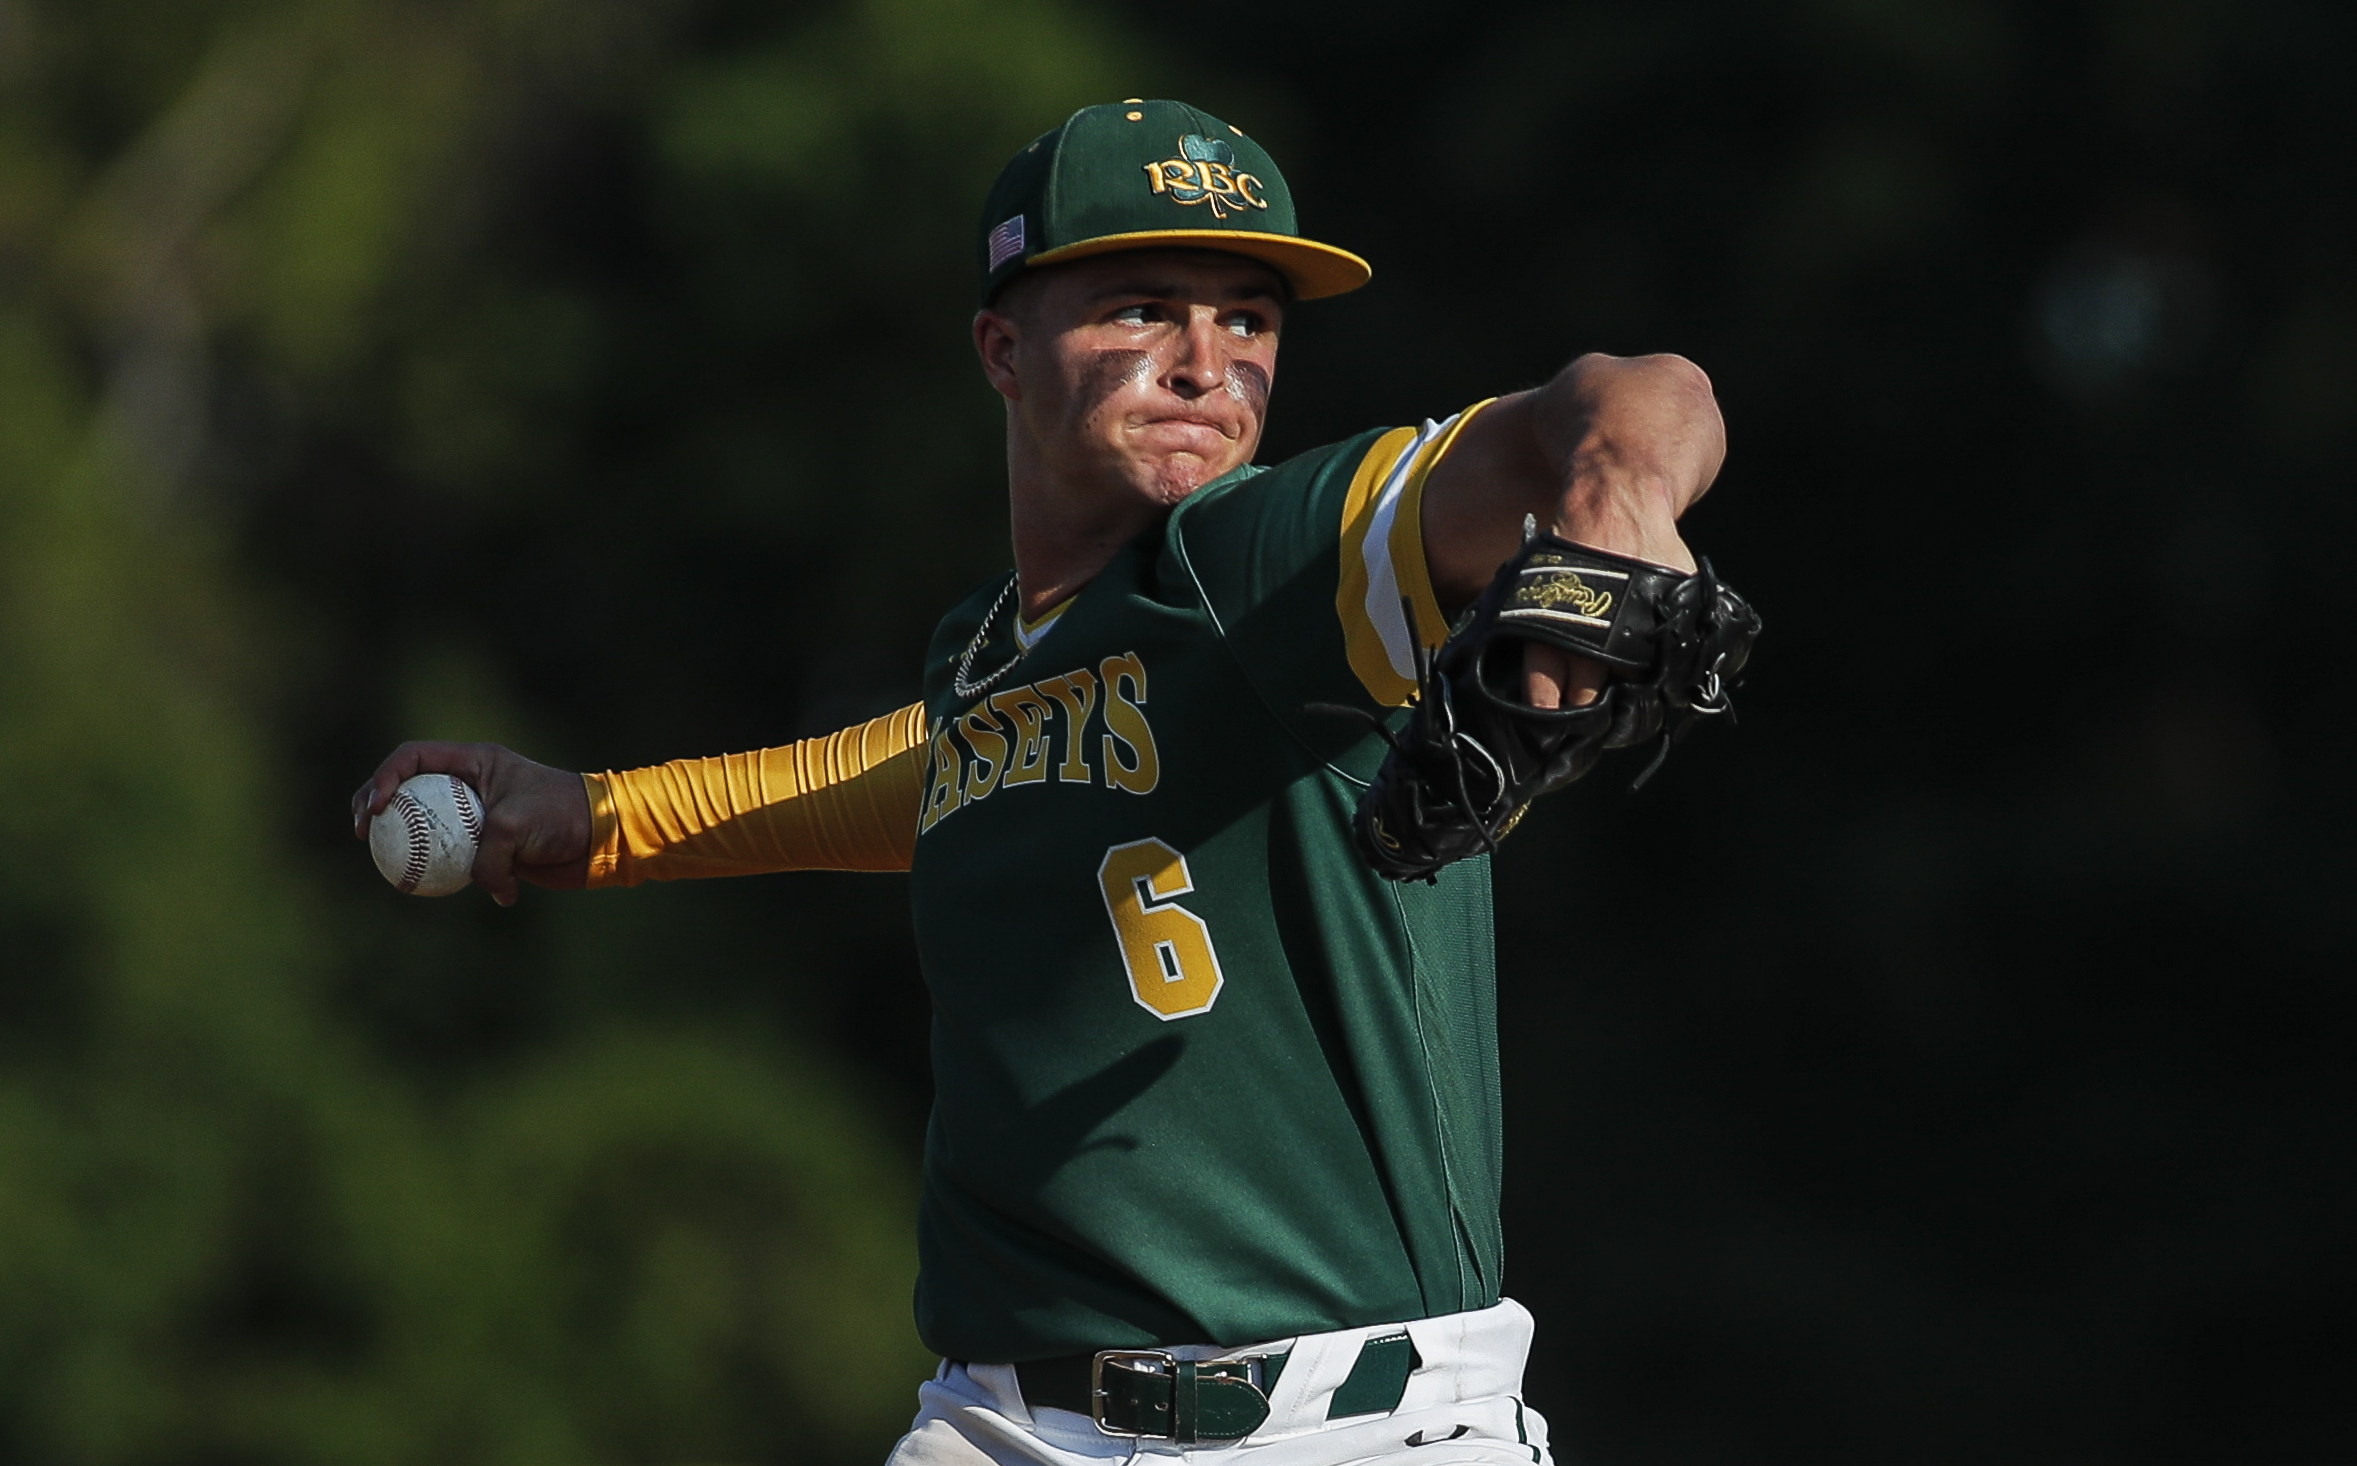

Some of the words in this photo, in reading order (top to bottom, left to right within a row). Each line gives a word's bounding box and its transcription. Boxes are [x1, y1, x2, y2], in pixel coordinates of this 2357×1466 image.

[1142, 157, 1268, 210] RBC
[915, 651, 1160, 836] ASEYS
[1097, 836, 1224, 1021] 6
